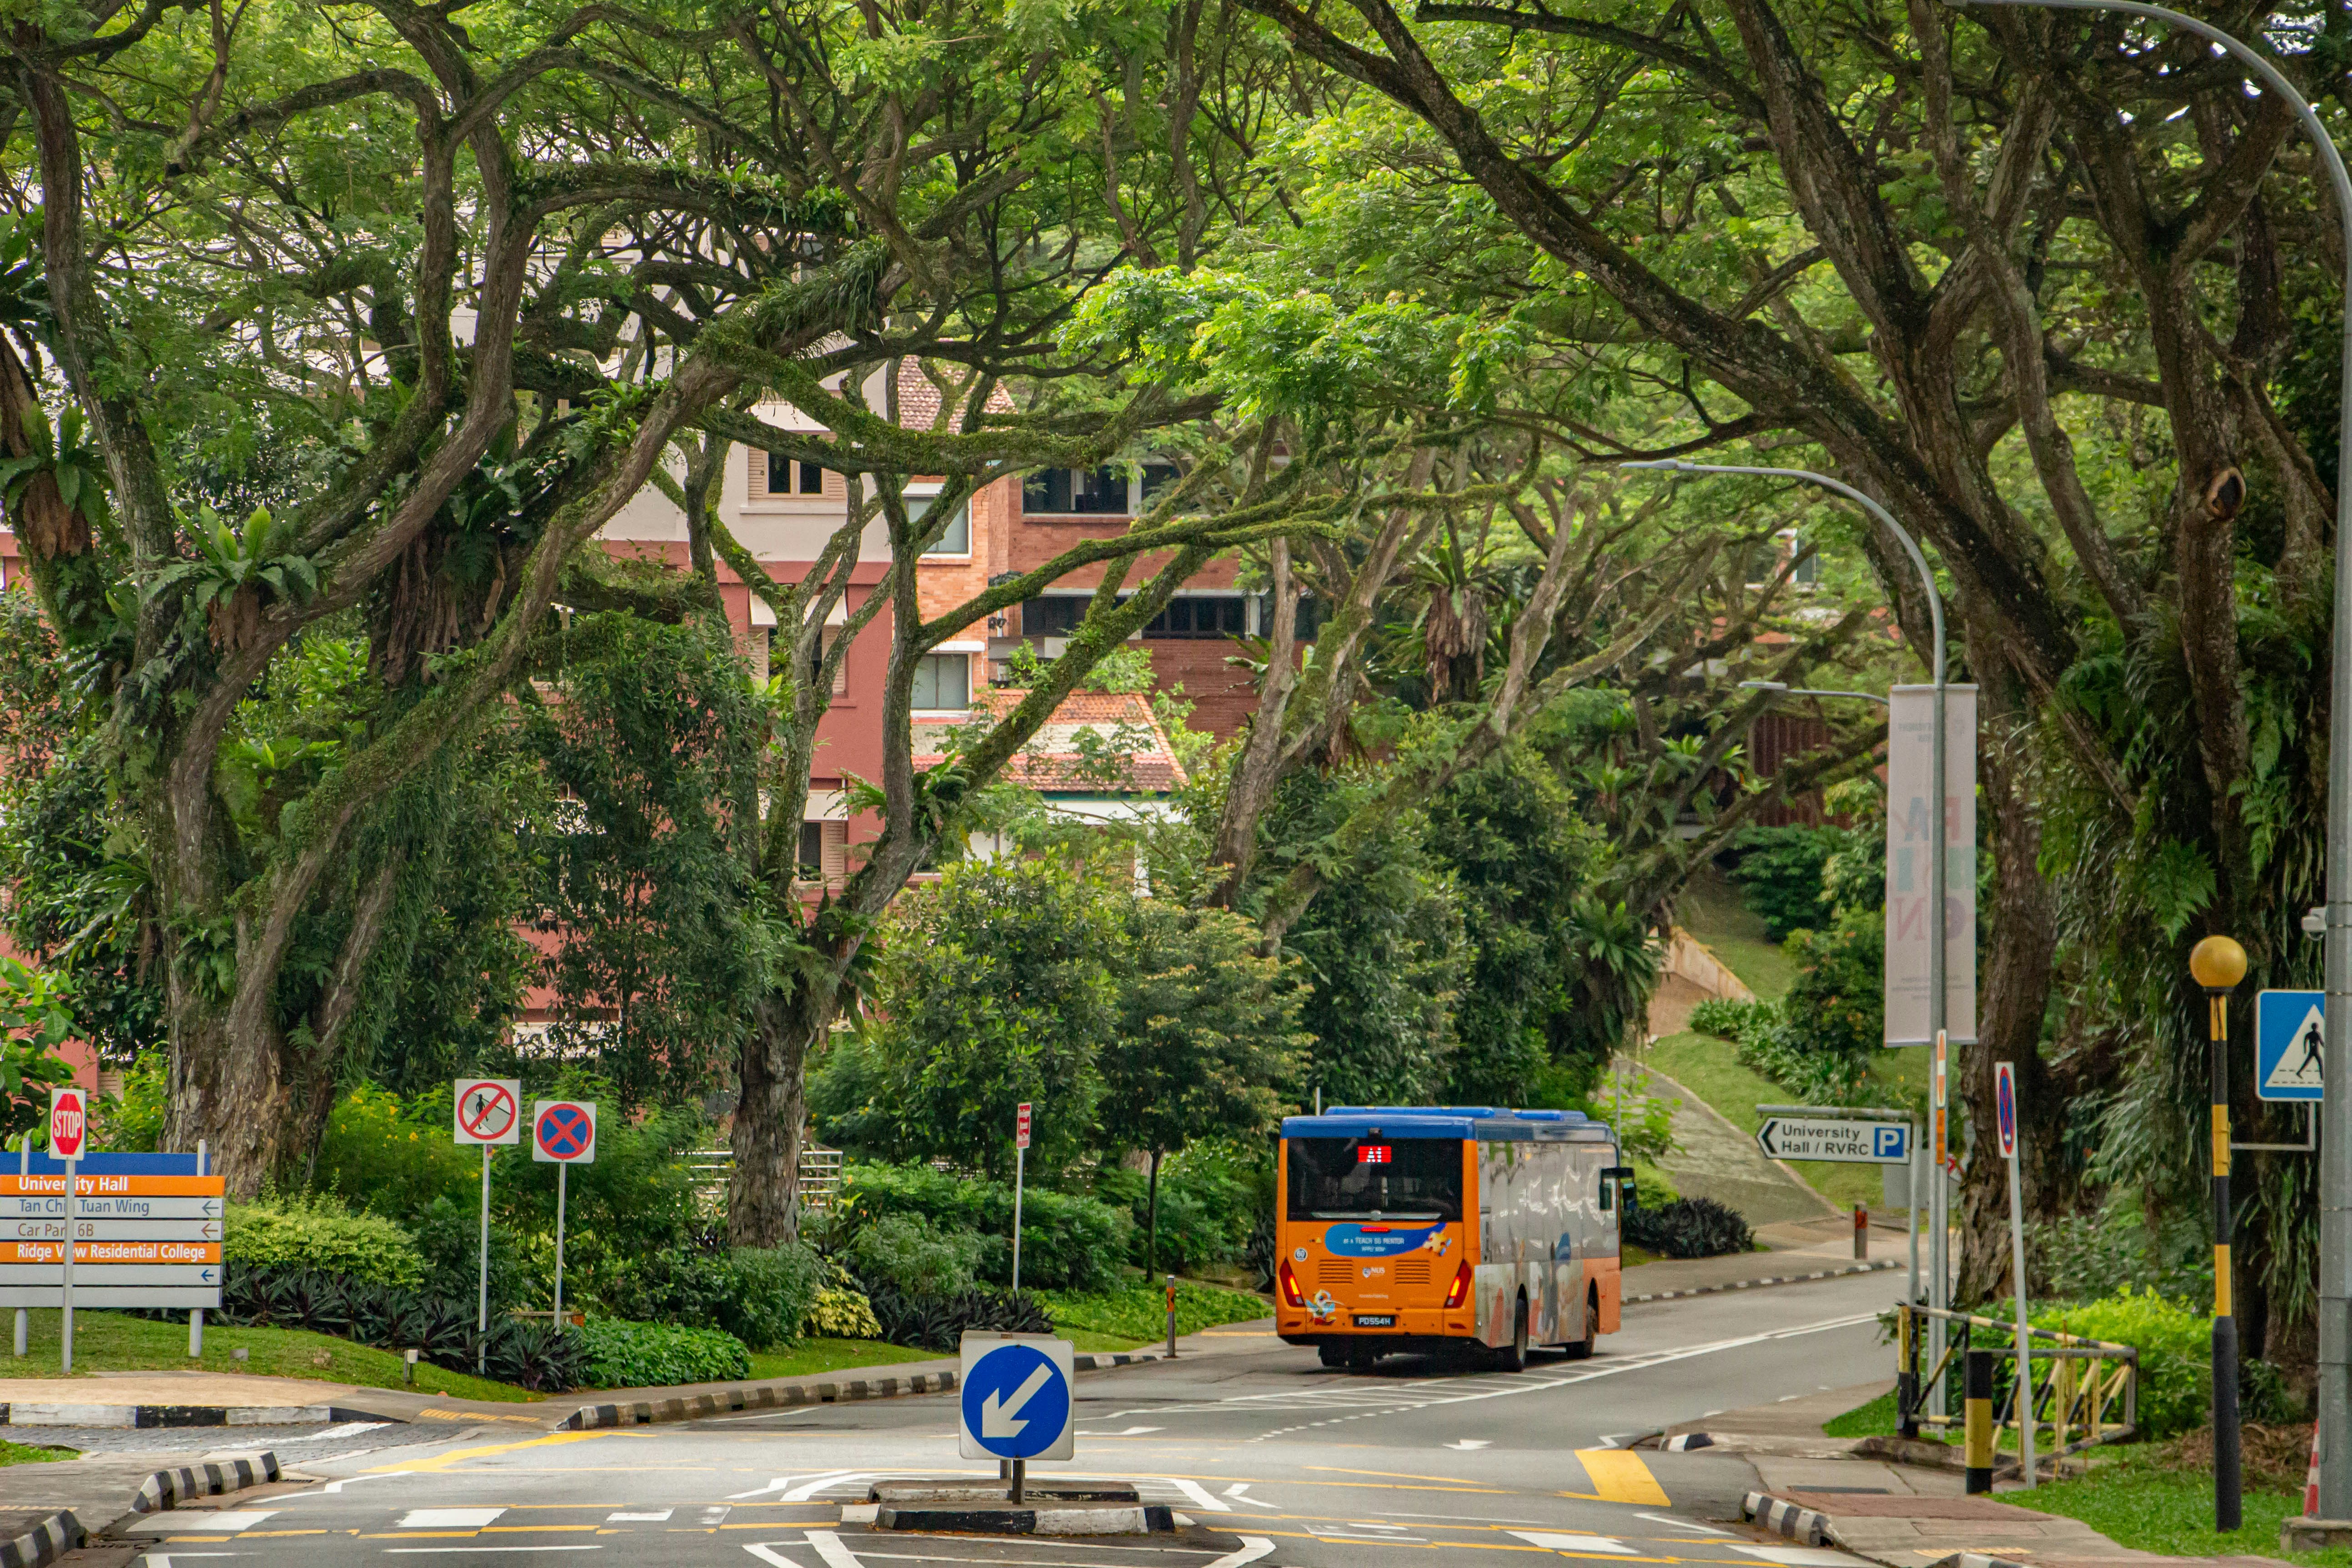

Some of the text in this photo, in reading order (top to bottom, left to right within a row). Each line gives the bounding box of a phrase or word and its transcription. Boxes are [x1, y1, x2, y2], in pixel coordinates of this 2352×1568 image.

[54, 1110, 81, 1138] STOP
[1783, 1124, 1861, 1142] University
[1782, 1141, 1810, 1153] Hall
[1825, 1142, 1869, 1155] RVRC
[1879, 1130, 1900, 1155] P
[1367, 1147, 1382, 1162] A1
[19, 1177, 128, 1194] Univerity Hall
[19, 1198, 150, 1217] Tan Chi Tuan Wing
[18, 1223, 94, 1237] Car Par 6B
[17, 1243, 51, 1262] Ridge
[90, 1244, 156, 1258] Residential
[160, 1244, 206, 1262] College
